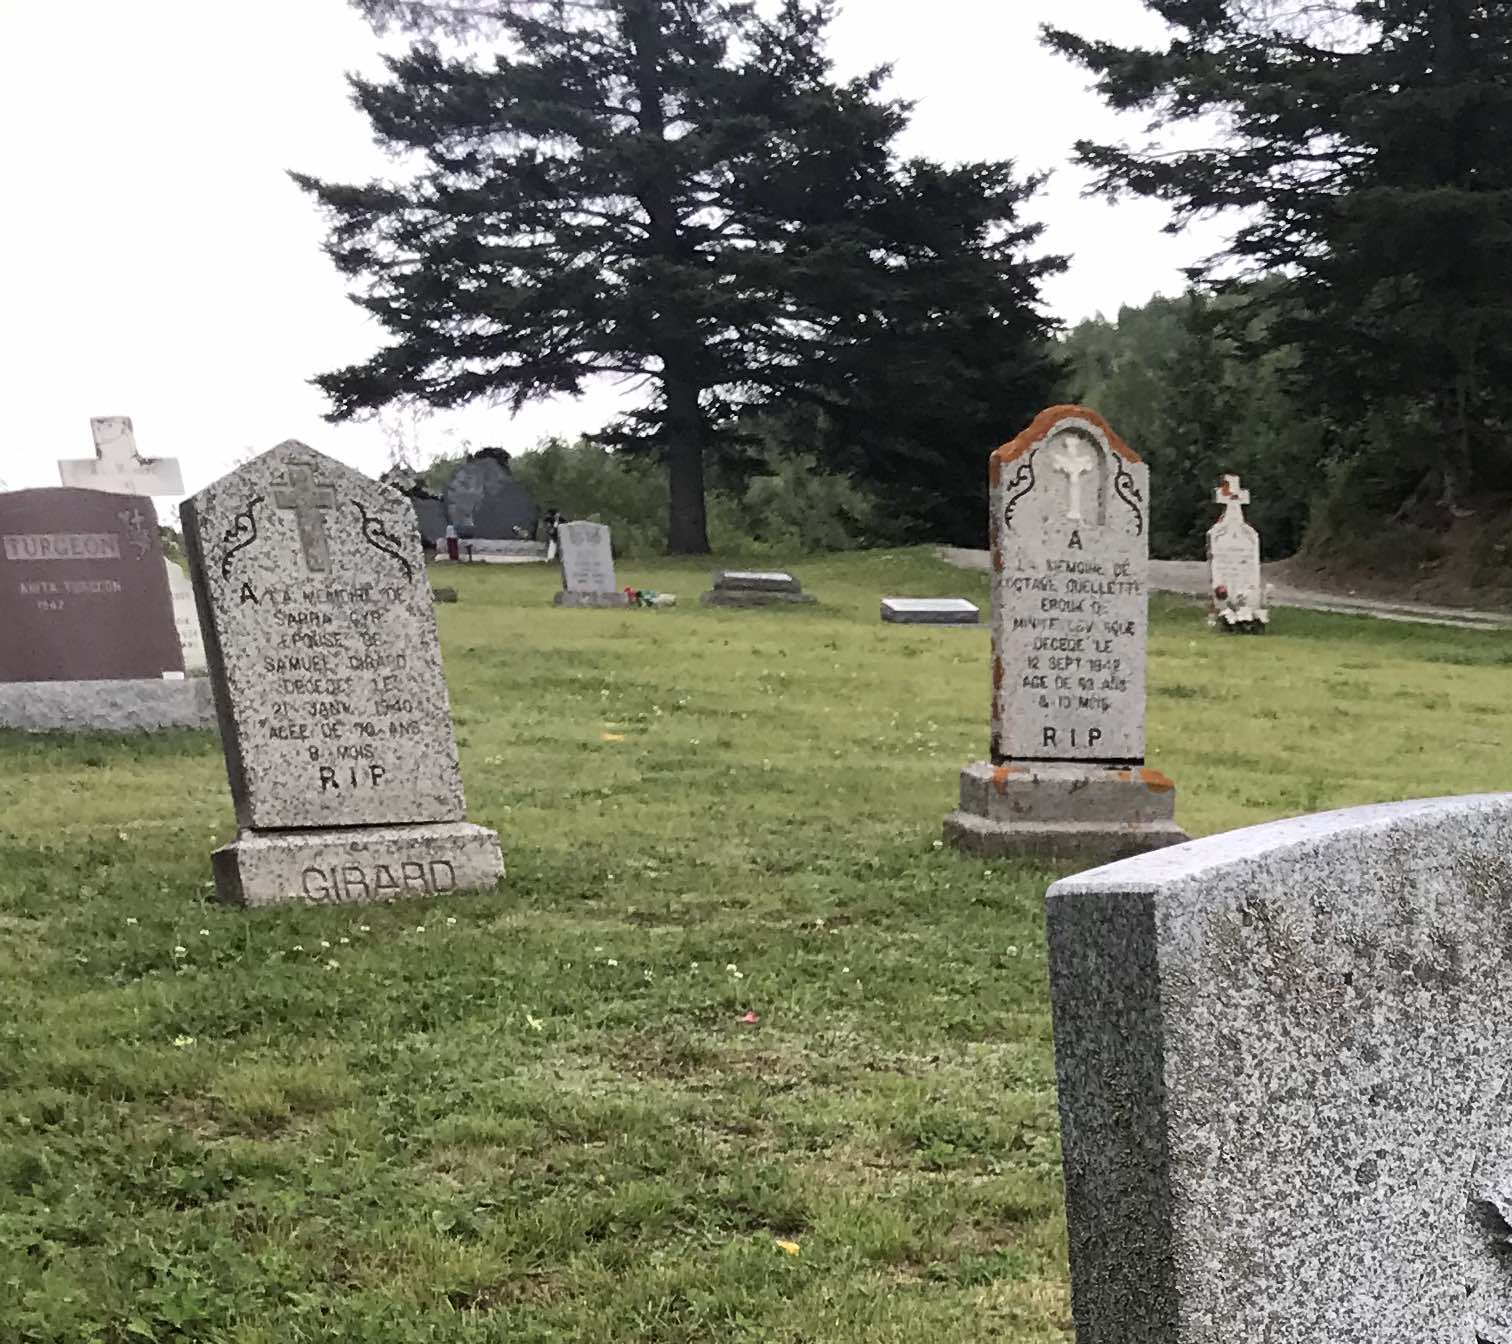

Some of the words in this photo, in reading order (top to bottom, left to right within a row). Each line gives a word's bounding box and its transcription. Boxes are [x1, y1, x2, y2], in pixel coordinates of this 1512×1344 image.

[7, 537, 118, 557] TURGEON
[1068, 530, 1082, 550] A
[240, 583, 258, 604] A
[1094, 639, 1113, 653] LE
[264, 654, 335, 674] SAMUEL
[1028, 656, 1040, 669] 12
[1048, 655, 1082, 671] SEPT
[1023, 675, 1048, 688] AGE
[1055, 675, 1072, 690] DE
[337, 744, 374, 761] MOIS
[302, 860, 457, 901] GIRARD
